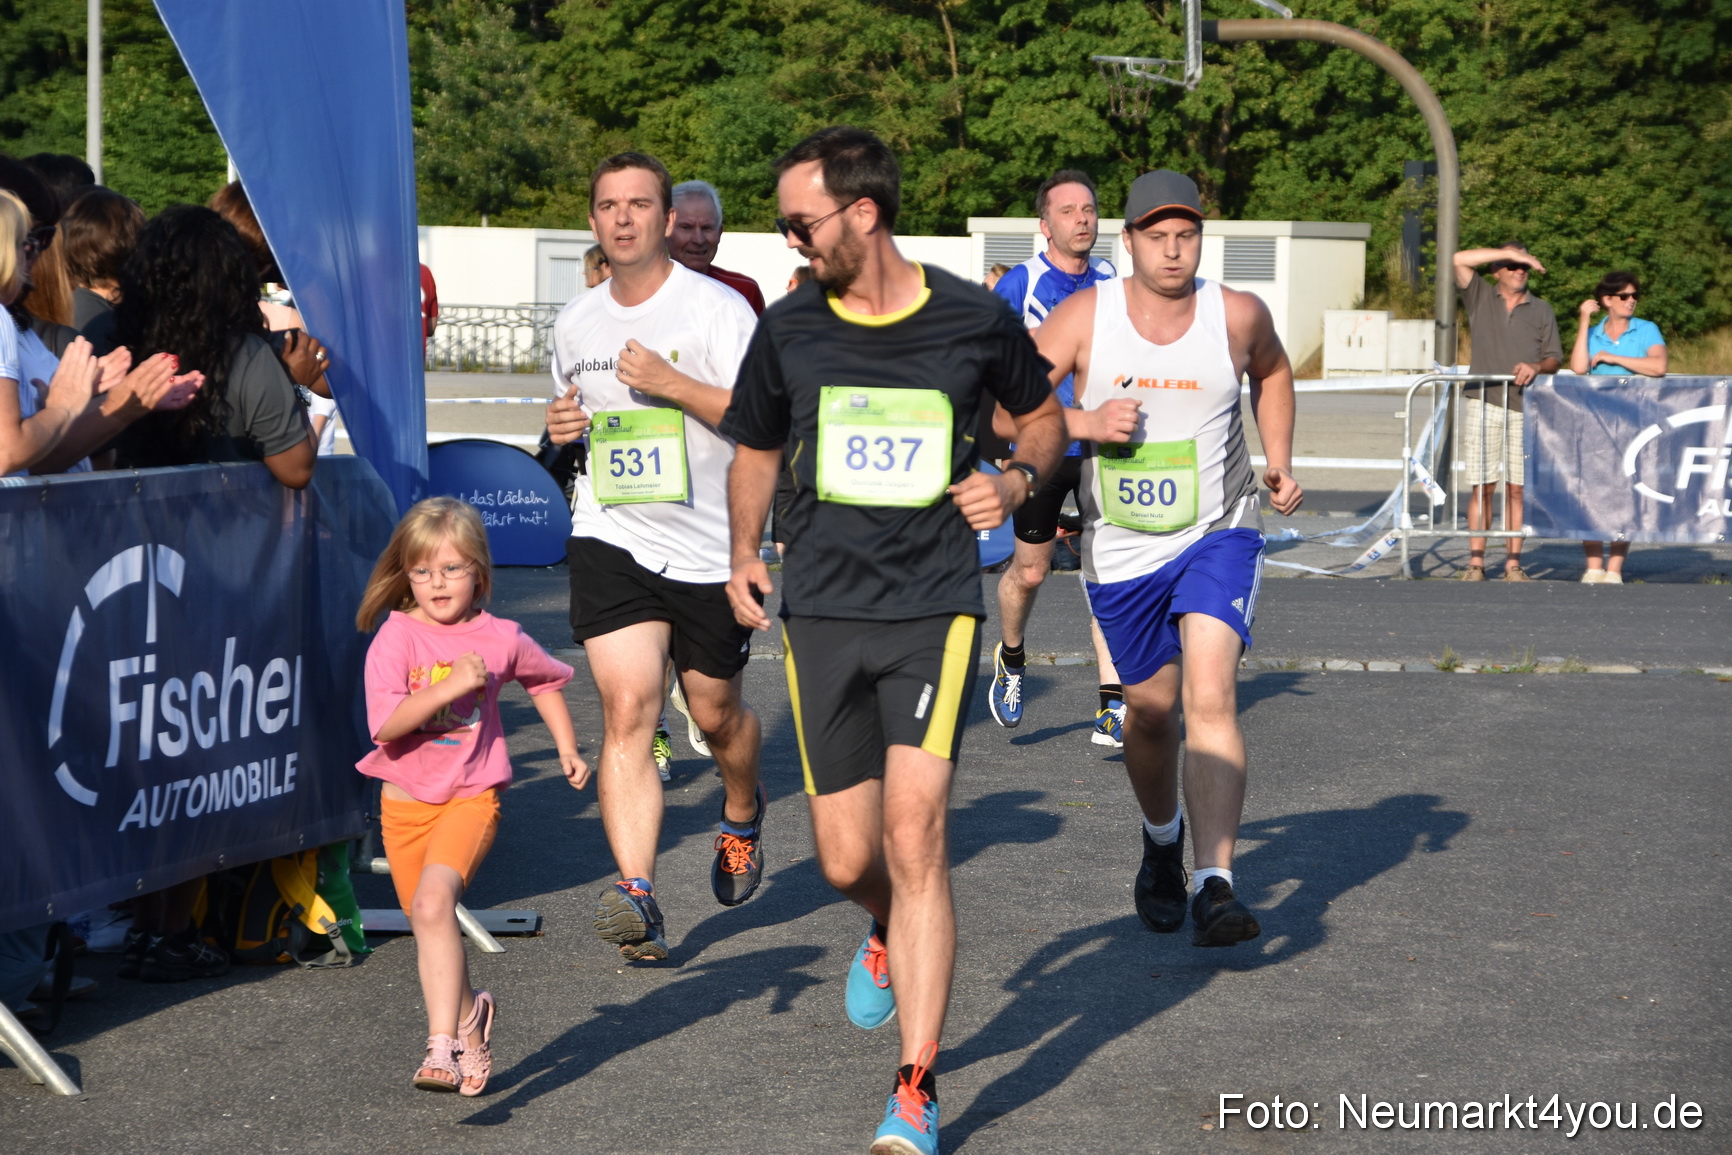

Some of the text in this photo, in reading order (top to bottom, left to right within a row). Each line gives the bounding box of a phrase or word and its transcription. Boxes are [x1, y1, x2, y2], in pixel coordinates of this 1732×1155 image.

[1137, 378, 1204, 390] KLEBL
[609, 446, 661, 477] 531
[845, 434, 923, 471] 837
[1676, 446, 1732, 490] Fi
[469, 489, 494, 506] das
[497, 489, 549, 506] Lächeln
[1118, 477, 1177, 506] 580
[519, 511, 547, 525] mit!
[118, 752, 298, 831] AUTOMOBILE
